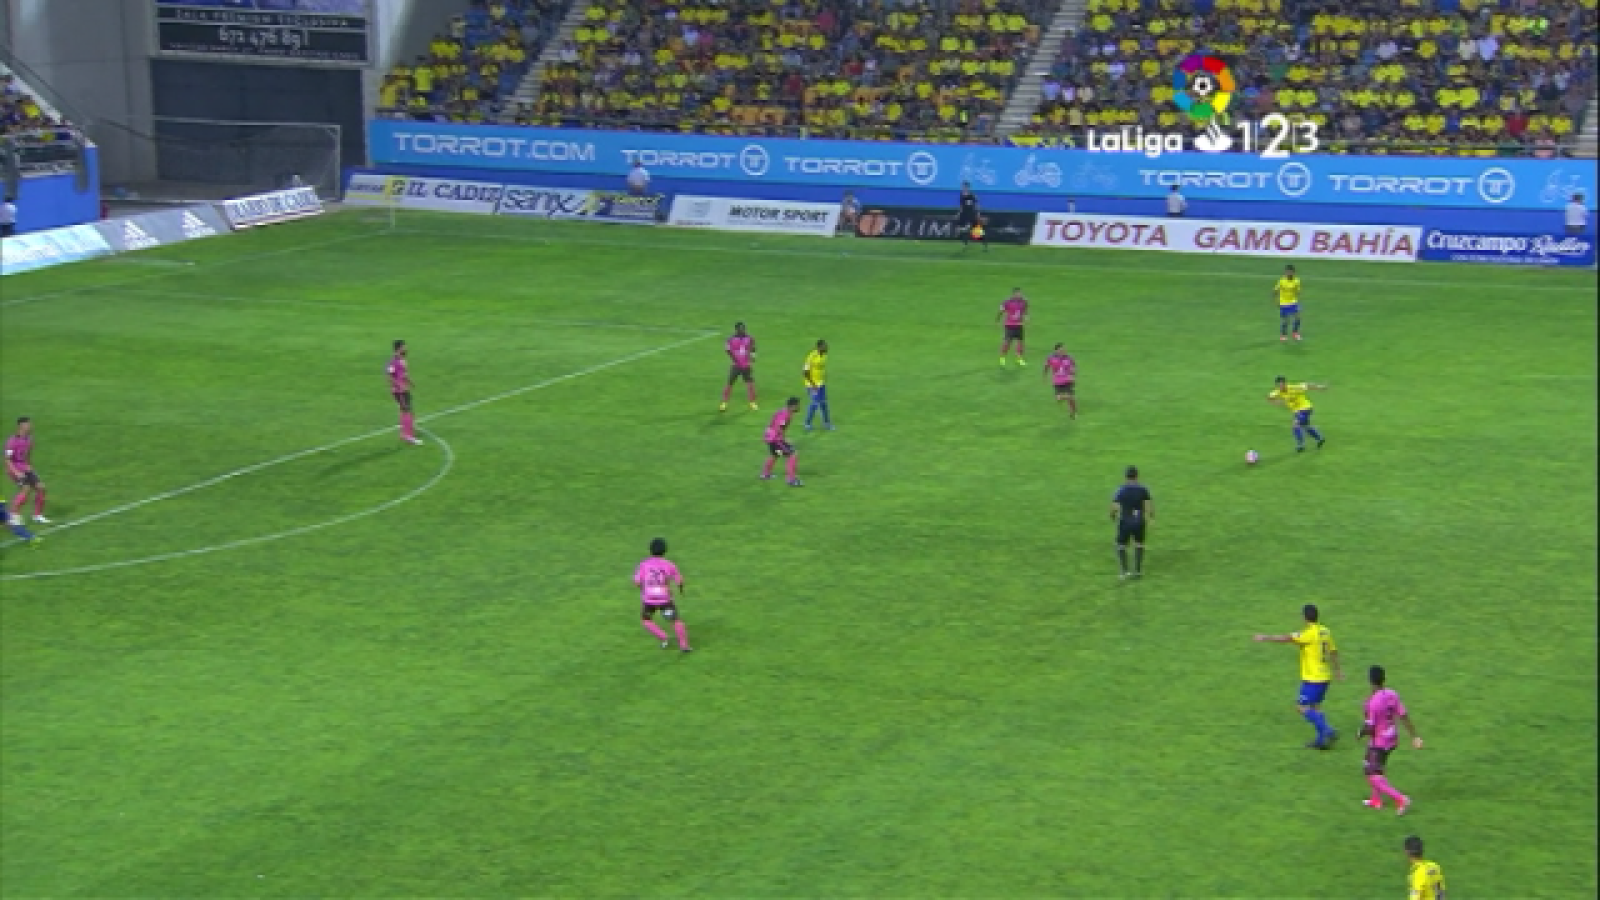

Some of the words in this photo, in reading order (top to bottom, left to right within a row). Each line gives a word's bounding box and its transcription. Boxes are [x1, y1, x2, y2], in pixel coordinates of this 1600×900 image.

[393, 131, 596, 162] TORROT.COM
[621, 148, 736, 168] TORROT
[784, 156, 903, 176] TORROT
[1138, 168, 1273, 190] TORROT
[1327, 174, 1475, 196] TORROT
[729, 204, 780, 220] MOTOR
[782, 209, 829, 223] SPORT
[1044, 219, 1169, 246] TOYOTA
[1194, 225, 1300, 253] GAMO
[1309, 227, 1414, 256] BAHÍA
[1427, 229, 1527, 254] Cruzcampo
